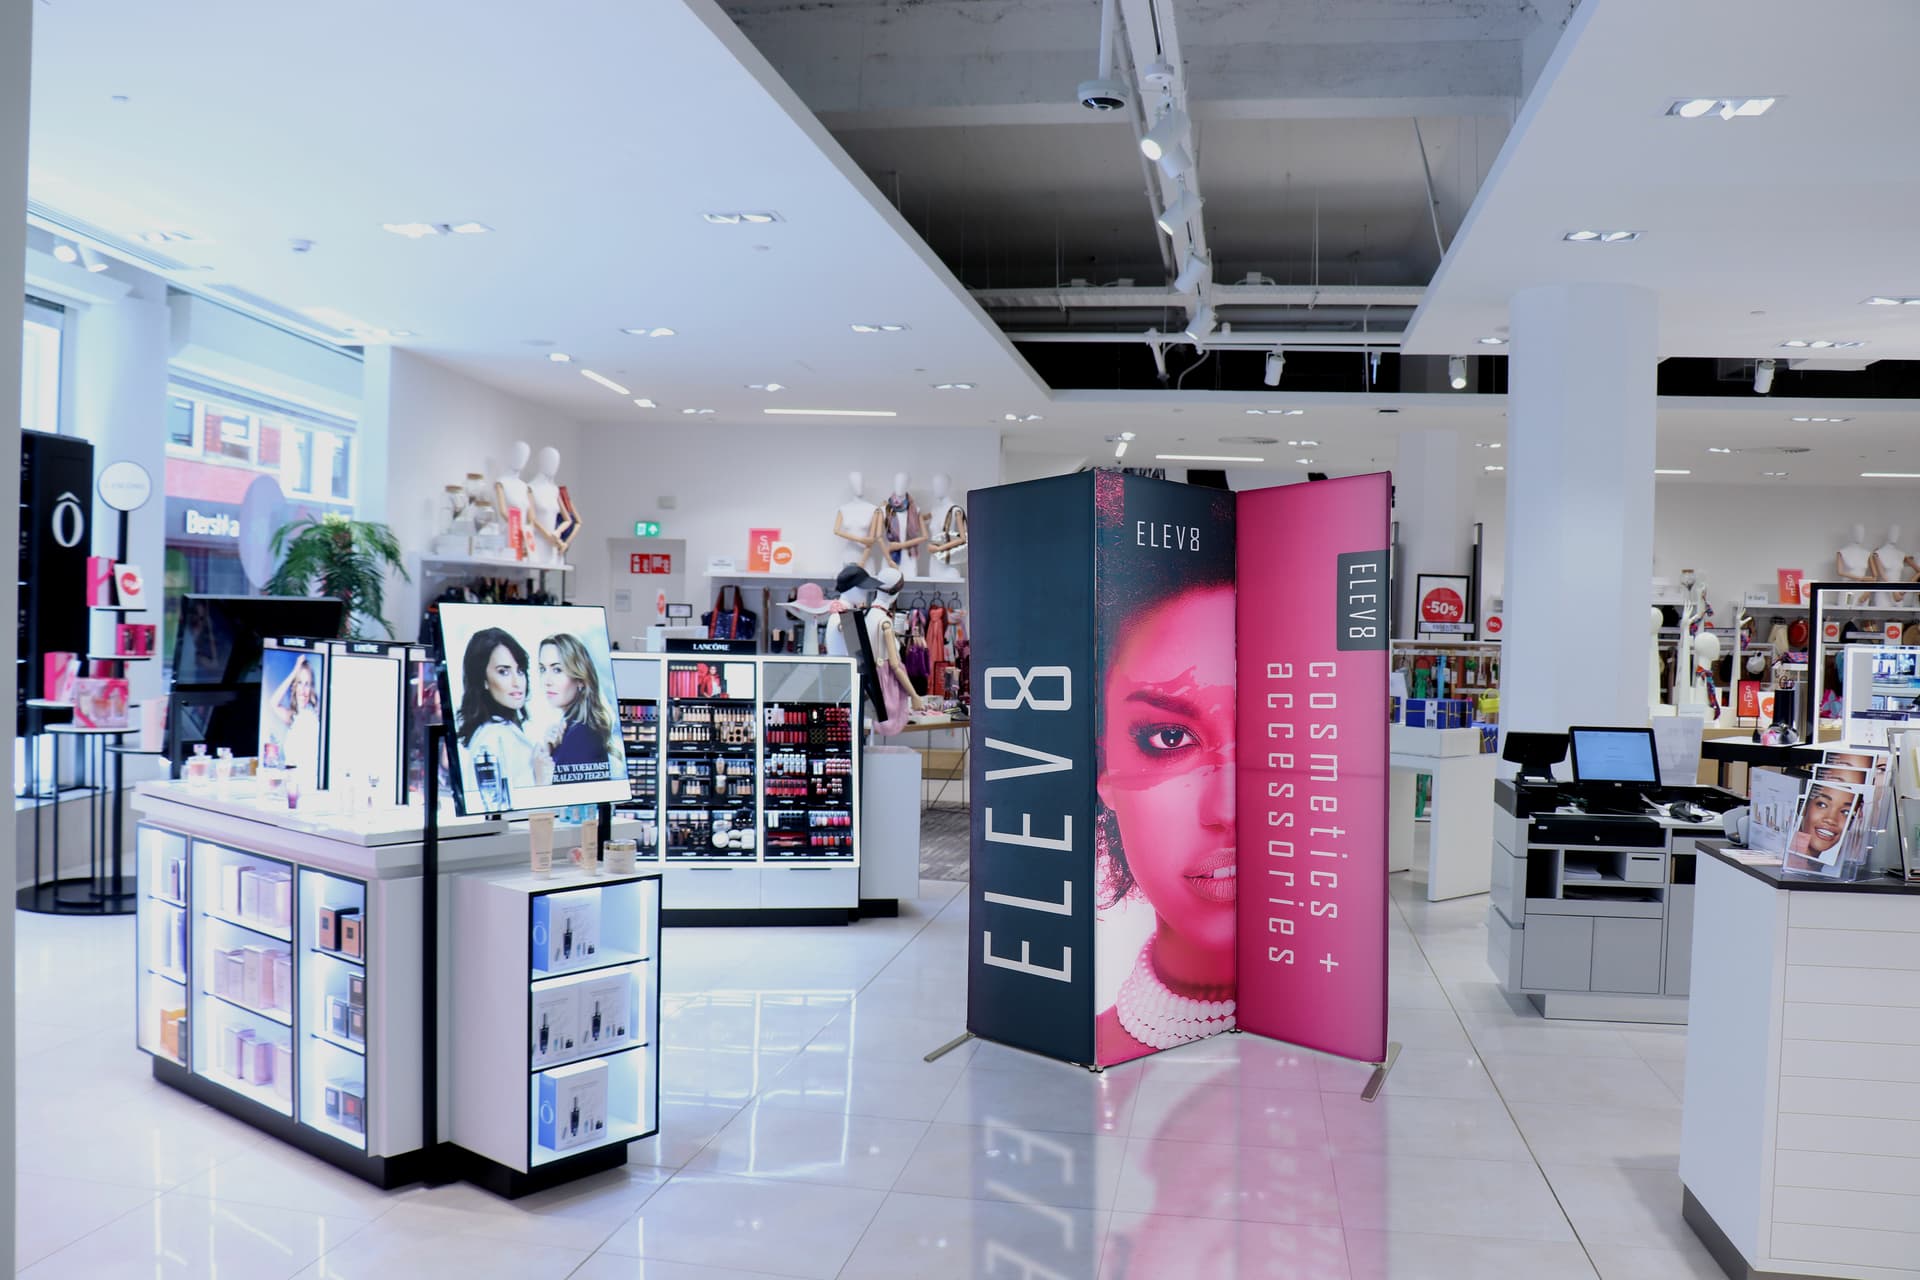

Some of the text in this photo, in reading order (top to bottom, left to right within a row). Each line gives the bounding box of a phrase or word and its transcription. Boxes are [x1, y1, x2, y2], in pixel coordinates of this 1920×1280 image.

[1137, 520, 1199, 551] ELEV8
[1350, 563, 1376, 638] ELEV8
[1426, 600, 1458, 616] -50%
[983, 666, 1073, 983] ELEV8
[1266, 663, 1304, 965] accessories
[1309, 662, 1348, 919] cosmetics
